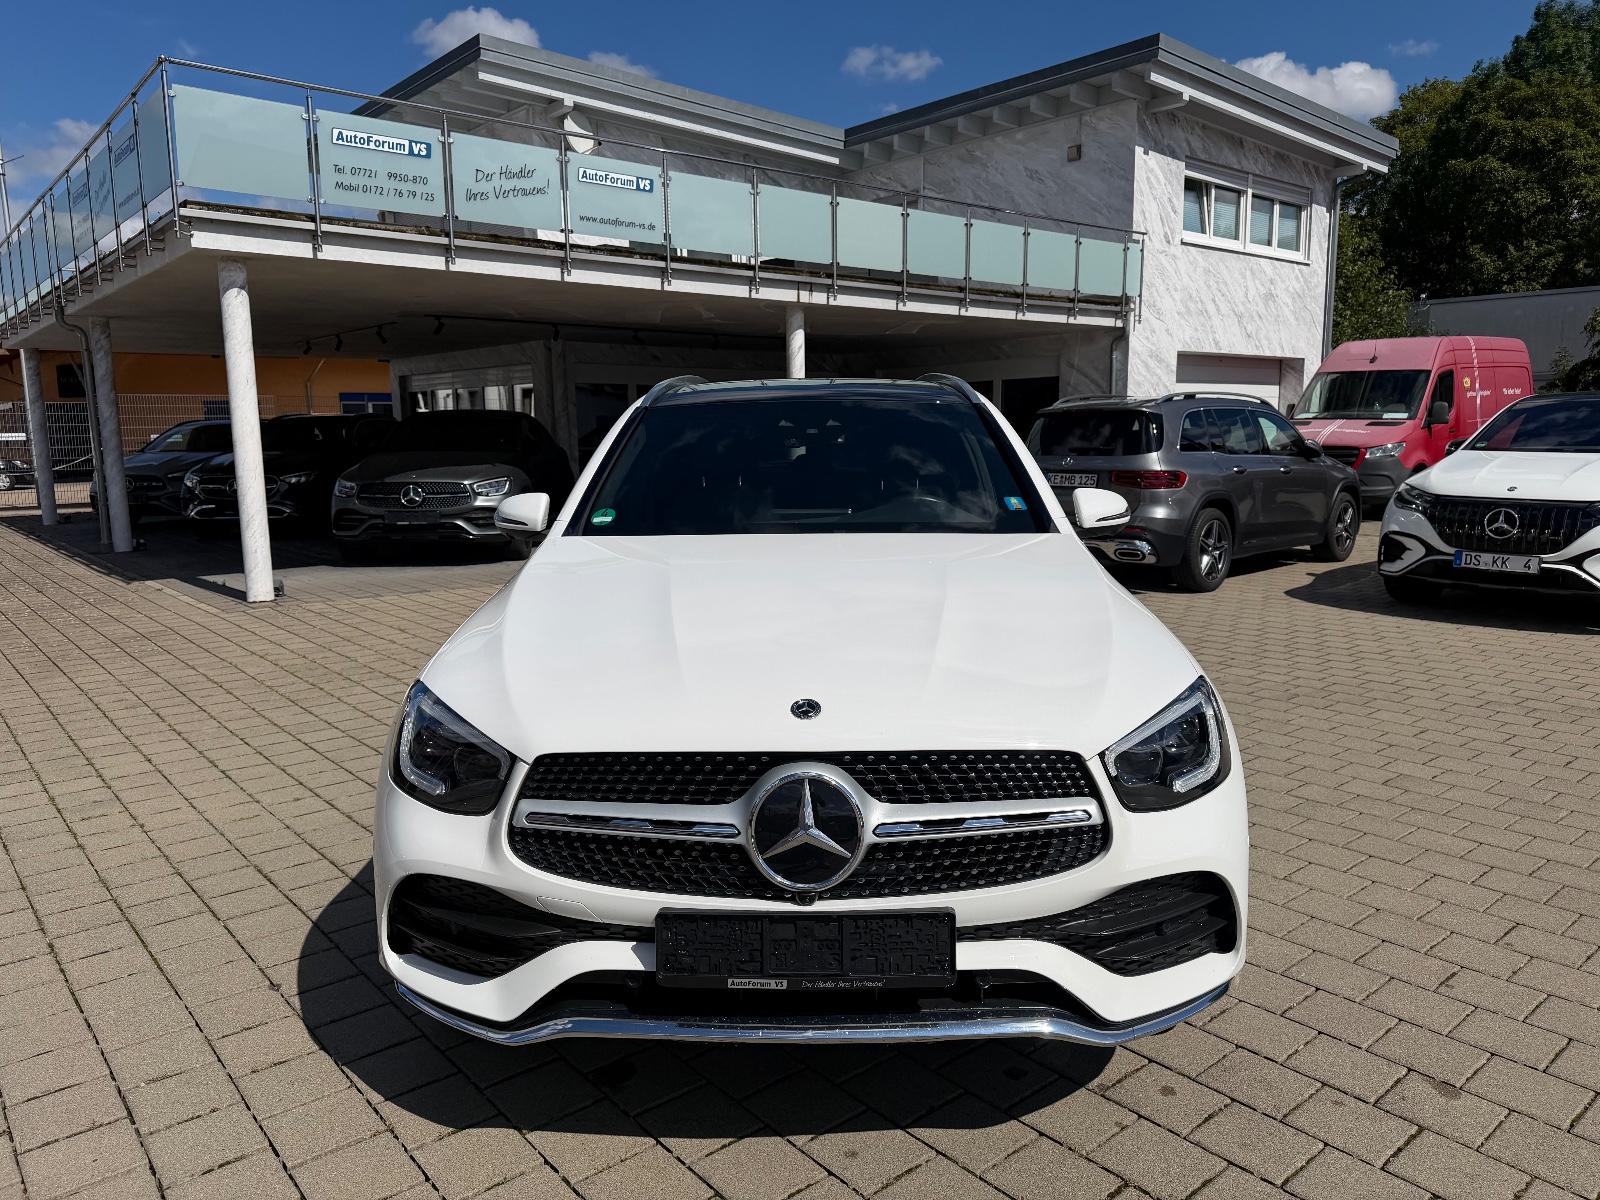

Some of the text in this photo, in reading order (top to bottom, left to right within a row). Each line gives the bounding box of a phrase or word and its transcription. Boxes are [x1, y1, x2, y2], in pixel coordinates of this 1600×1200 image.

[335, 130, 427, 156] AutoForum VS
[333, 164, 429, 186] Tel. 07721 9950-870
[475, 163, 537, 183] Der Händler
[581, 169, 651, 191] AutoForum VS
[334, 180, 360, 193] Mobil
[362, 184, 384, 196] 0172
[393, 188, 404, 198] 76
[406, 189, 417, 199] 79
[420, 191, 436, 202] 125
[465, 177, 550, 202] Ihres Vertrauens!
[579, 214, 656, 231] www.autoforum-vs.de
[1078, 475, 1096, 485] 125
[1464, 554, 1532, 571] DS KK 4
[729, 980, 784, 988] AutoForum VS
